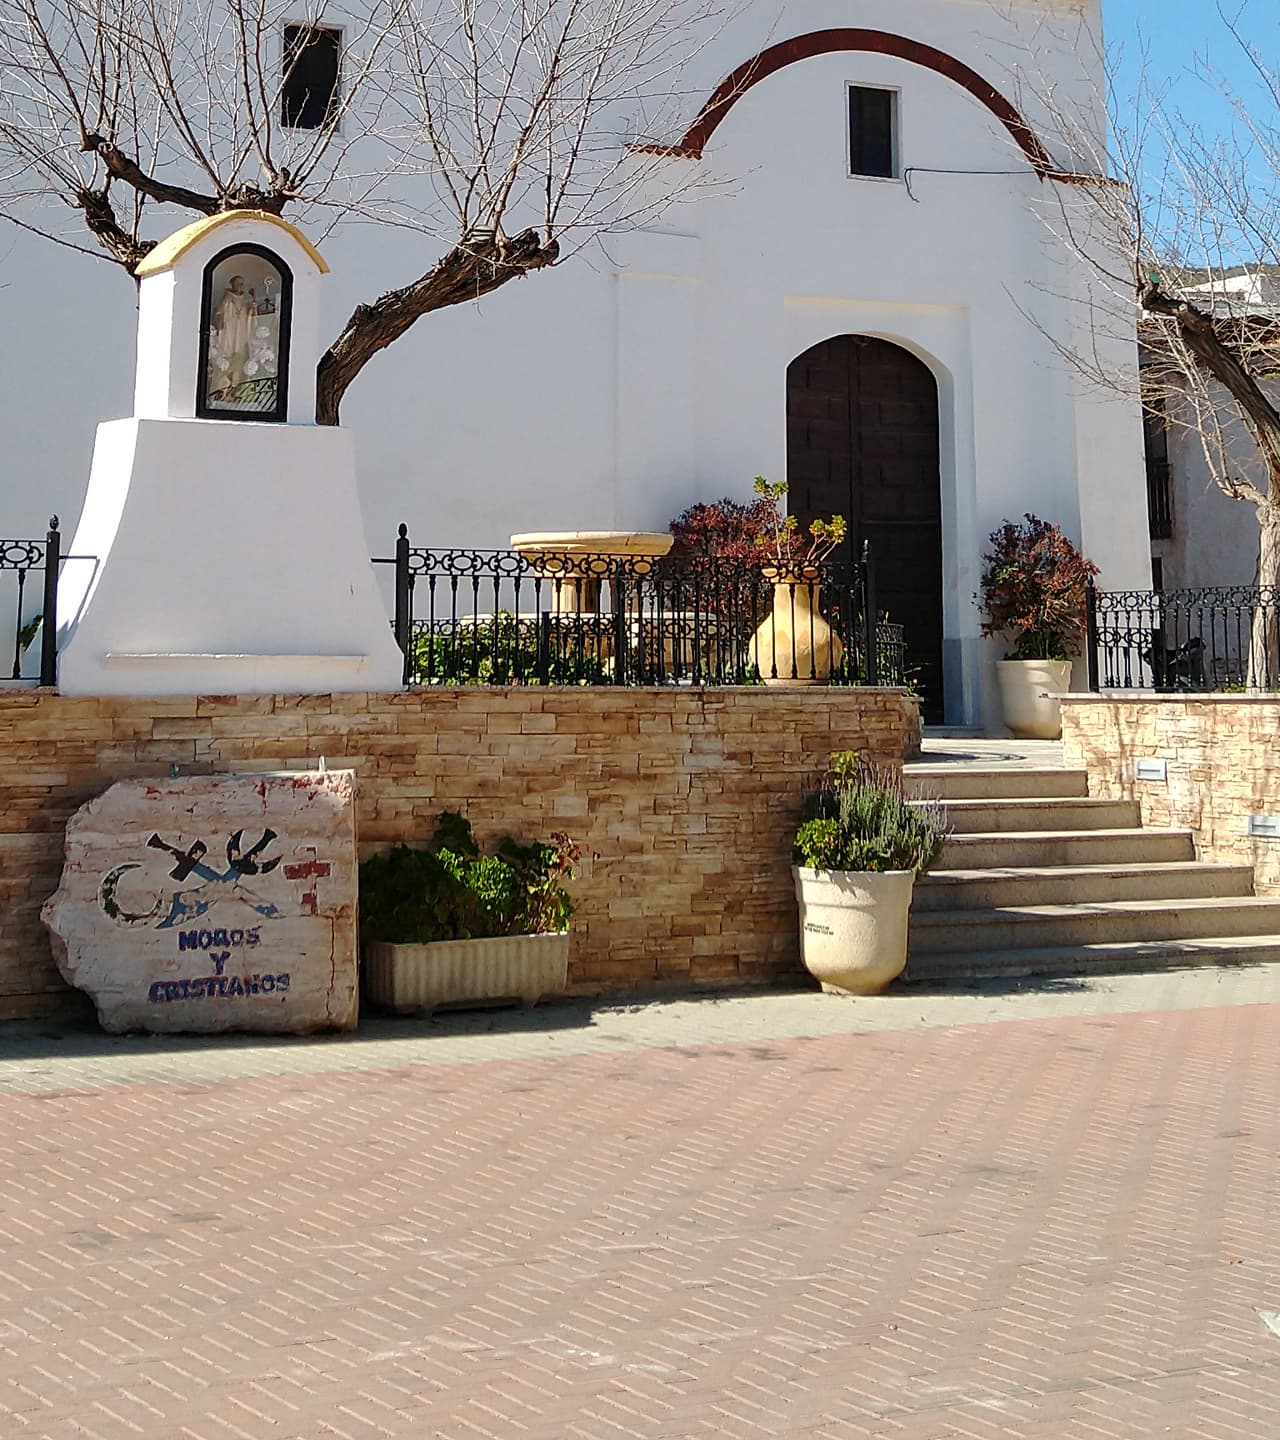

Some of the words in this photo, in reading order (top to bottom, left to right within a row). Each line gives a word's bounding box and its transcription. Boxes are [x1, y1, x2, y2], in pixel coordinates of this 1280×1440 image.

[177, 925, 263, 951] MOROS
[209, 951, 232, 975] Y
[148, 973, 291, 1003] CRISTIANOS
